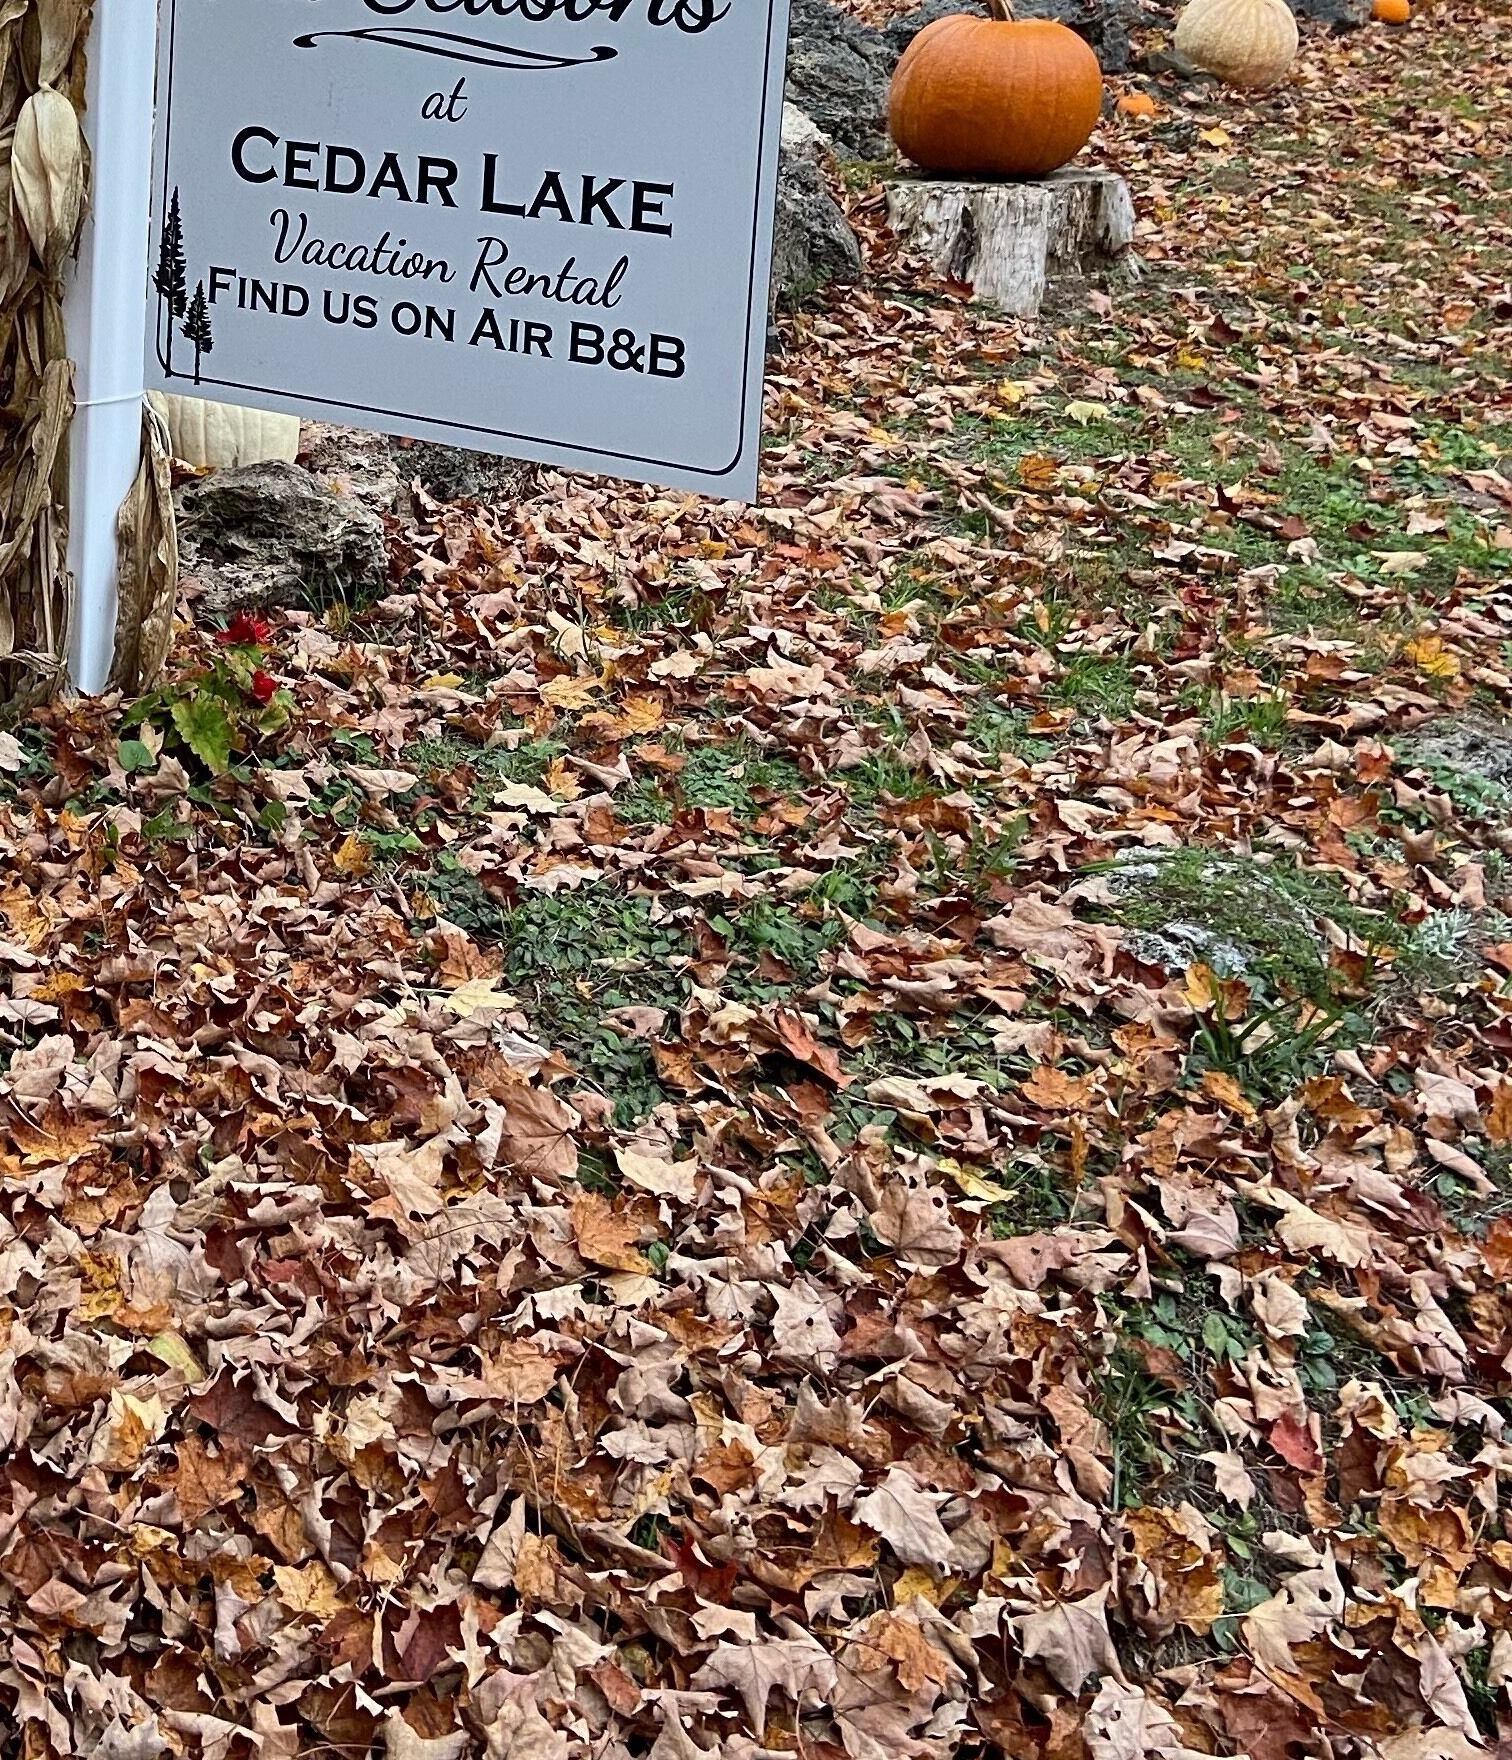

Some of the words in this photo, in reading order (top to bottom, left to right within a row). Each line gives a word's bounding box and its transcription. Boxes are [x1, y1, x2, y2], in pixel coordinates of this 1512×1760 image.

[421, 76, 468, 123] at
[269, 208, 457, 283] Vacation
[469, 236, 630, 309] Rental
[567, 320, 687, 380] B&B
